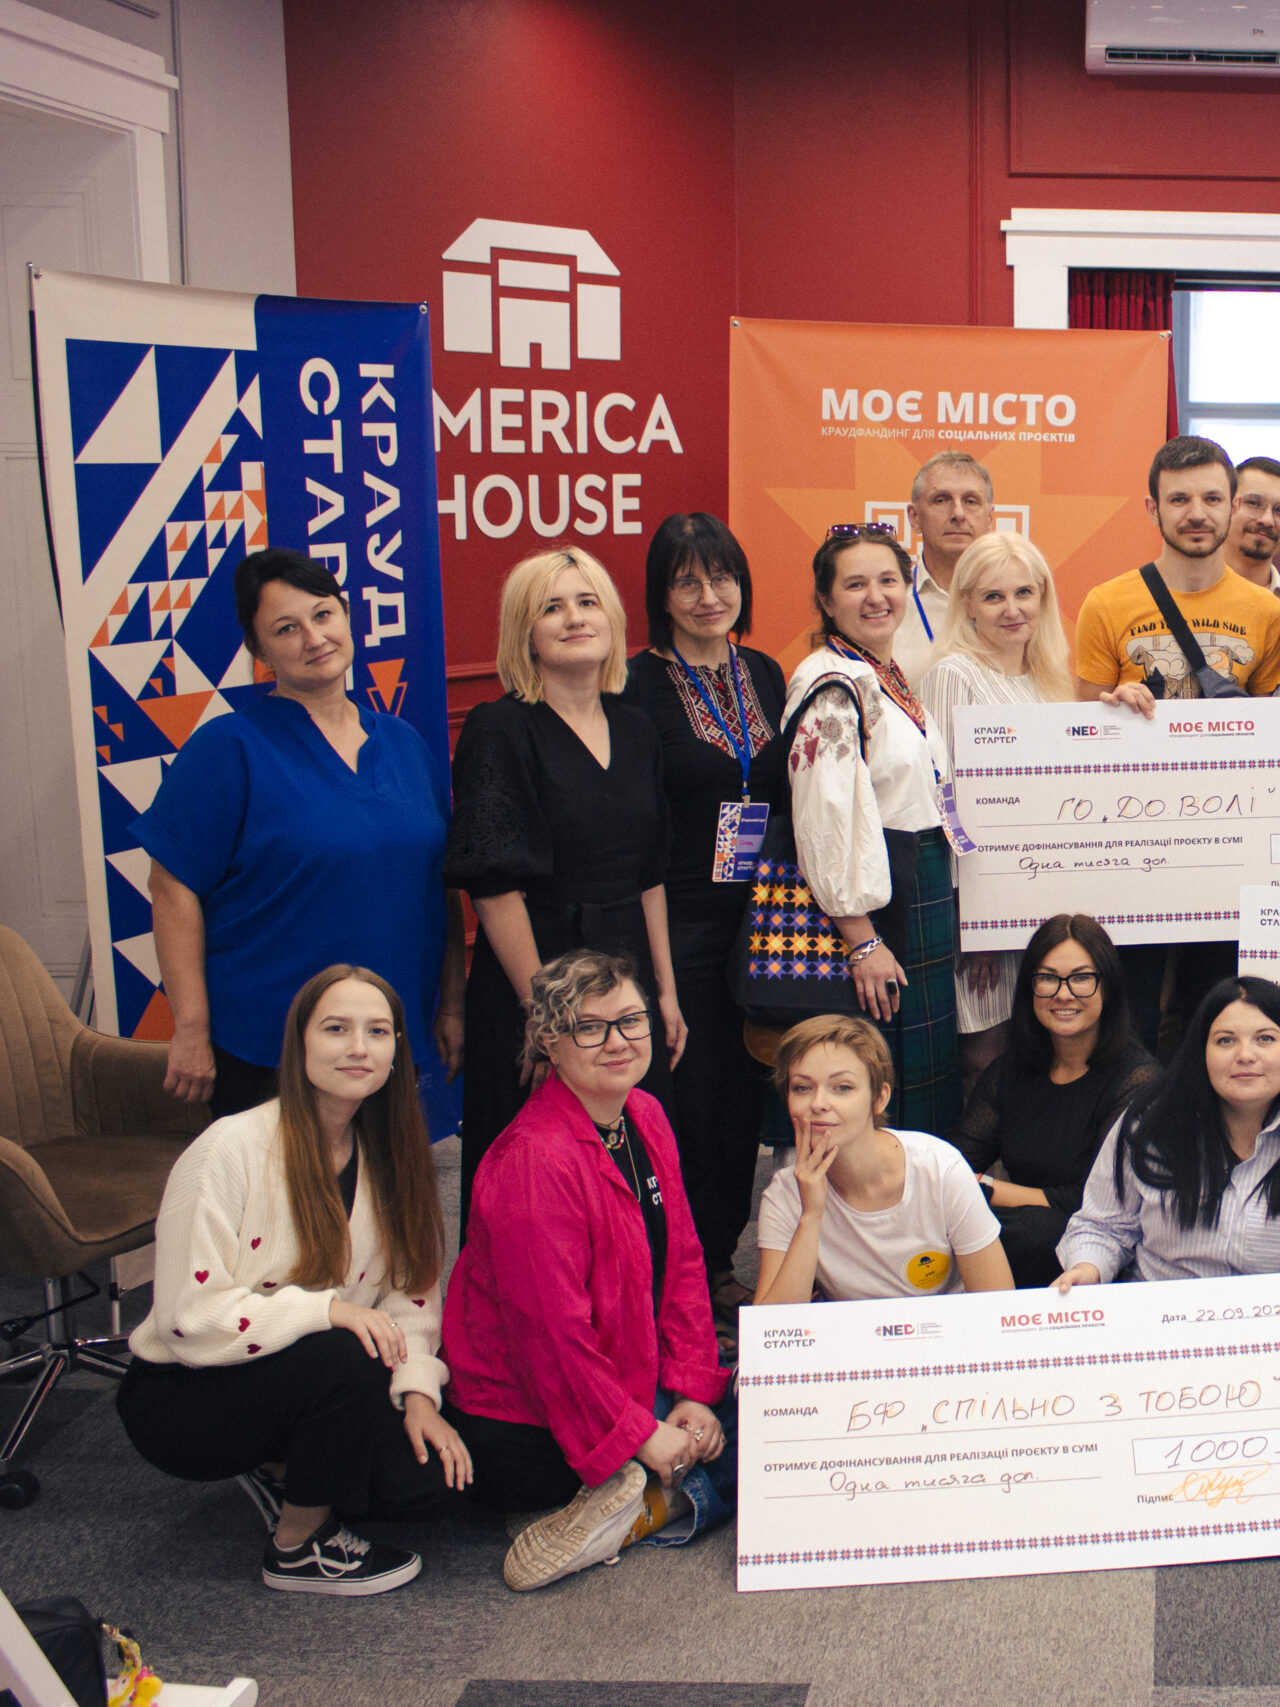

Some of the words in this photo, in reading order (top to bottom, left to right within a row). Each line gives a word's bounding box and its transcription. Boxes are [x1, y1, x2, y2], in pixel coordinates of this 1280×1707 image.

[821, 387, 923, 423] МОЄ
[937, 391, 1077, 427] МІСТО
[432, 388, 684, 455] MERICA
[821, 426, 911, 440] КРАУДФАНДИНГ
[912, 429, 936, 440] ДЛЯ
[938, 429, 1016, 442] СОЦІАЛЬНИХ
[1018, 431, 1076, 443] ПРОЄКТІВ
[358, 363, 407, 648] КРАУД
[437, 474, 643, 541] HOUSE
[299, 357, 354, 690] СТАР
[1191, 618, 1220, 629] WILD
[974, 726, 1006, 735] КРАУД
[1071, 725, 1099, 736] NED
[1169, 721, 1204, 734] МОЄ
[1208, 720, 1255, 732] МІСТО
[974, 736, 1017, 744] СТАРТЕР
[976, 796, 1020, 806] КОМАНДА
[1057, 797, 1093, 821] ГО
[977, 843, 1020, 853] ОТРИМУЄ
[1021, 840, 1103, 853] ДОФІНАНСУВАННЯ
[1105, 838, 1123, 849] ДЛЯ
[1125, 836, 1172, 848] РЕАЛІЗАЦІЇ
[1174, 836, 1212, 847] ПРОЄКТУ
[1214, 836, 1221, 845] В
[1222, 836, 1243, 845] СУМІ
[1019, 856, 1064, 880] Одна
[1000, 1313, 1043, 1328] МОЄ
[1048, 1309, 1105, 1325] МІСТО
[1162, 1313, 1187, 1325] Дата
[764, 1328, 803, 1338] КРАУД
[882, 1323, 915, 1337] NED
[764, 1339, 816, 1349] СТАРТЕР
[763, 1406, 819, 1417] КОМАНДА
[846, 1400, 906, 1433] БФ
[763, 1460, 818, 1473] ОТРИМУЄ
[819, 1455, 922, 1471] ДОФІНАНСУВАННЯ
[924, 1453, 948, 1466] ДЛЯ
[949, 1447, 1008, 1463] РЕАЛІЗАЦІЇ
[1011, 1446, 1060, 1459] ПРОЄКТУ
[1062, 1445, 1070, 1454] В
[1071, 1443, 1098, 1454] СУМІ
[829, 1471, 890, 1501] Одна
[1136, 1493, 1174, 1505] Підпис
